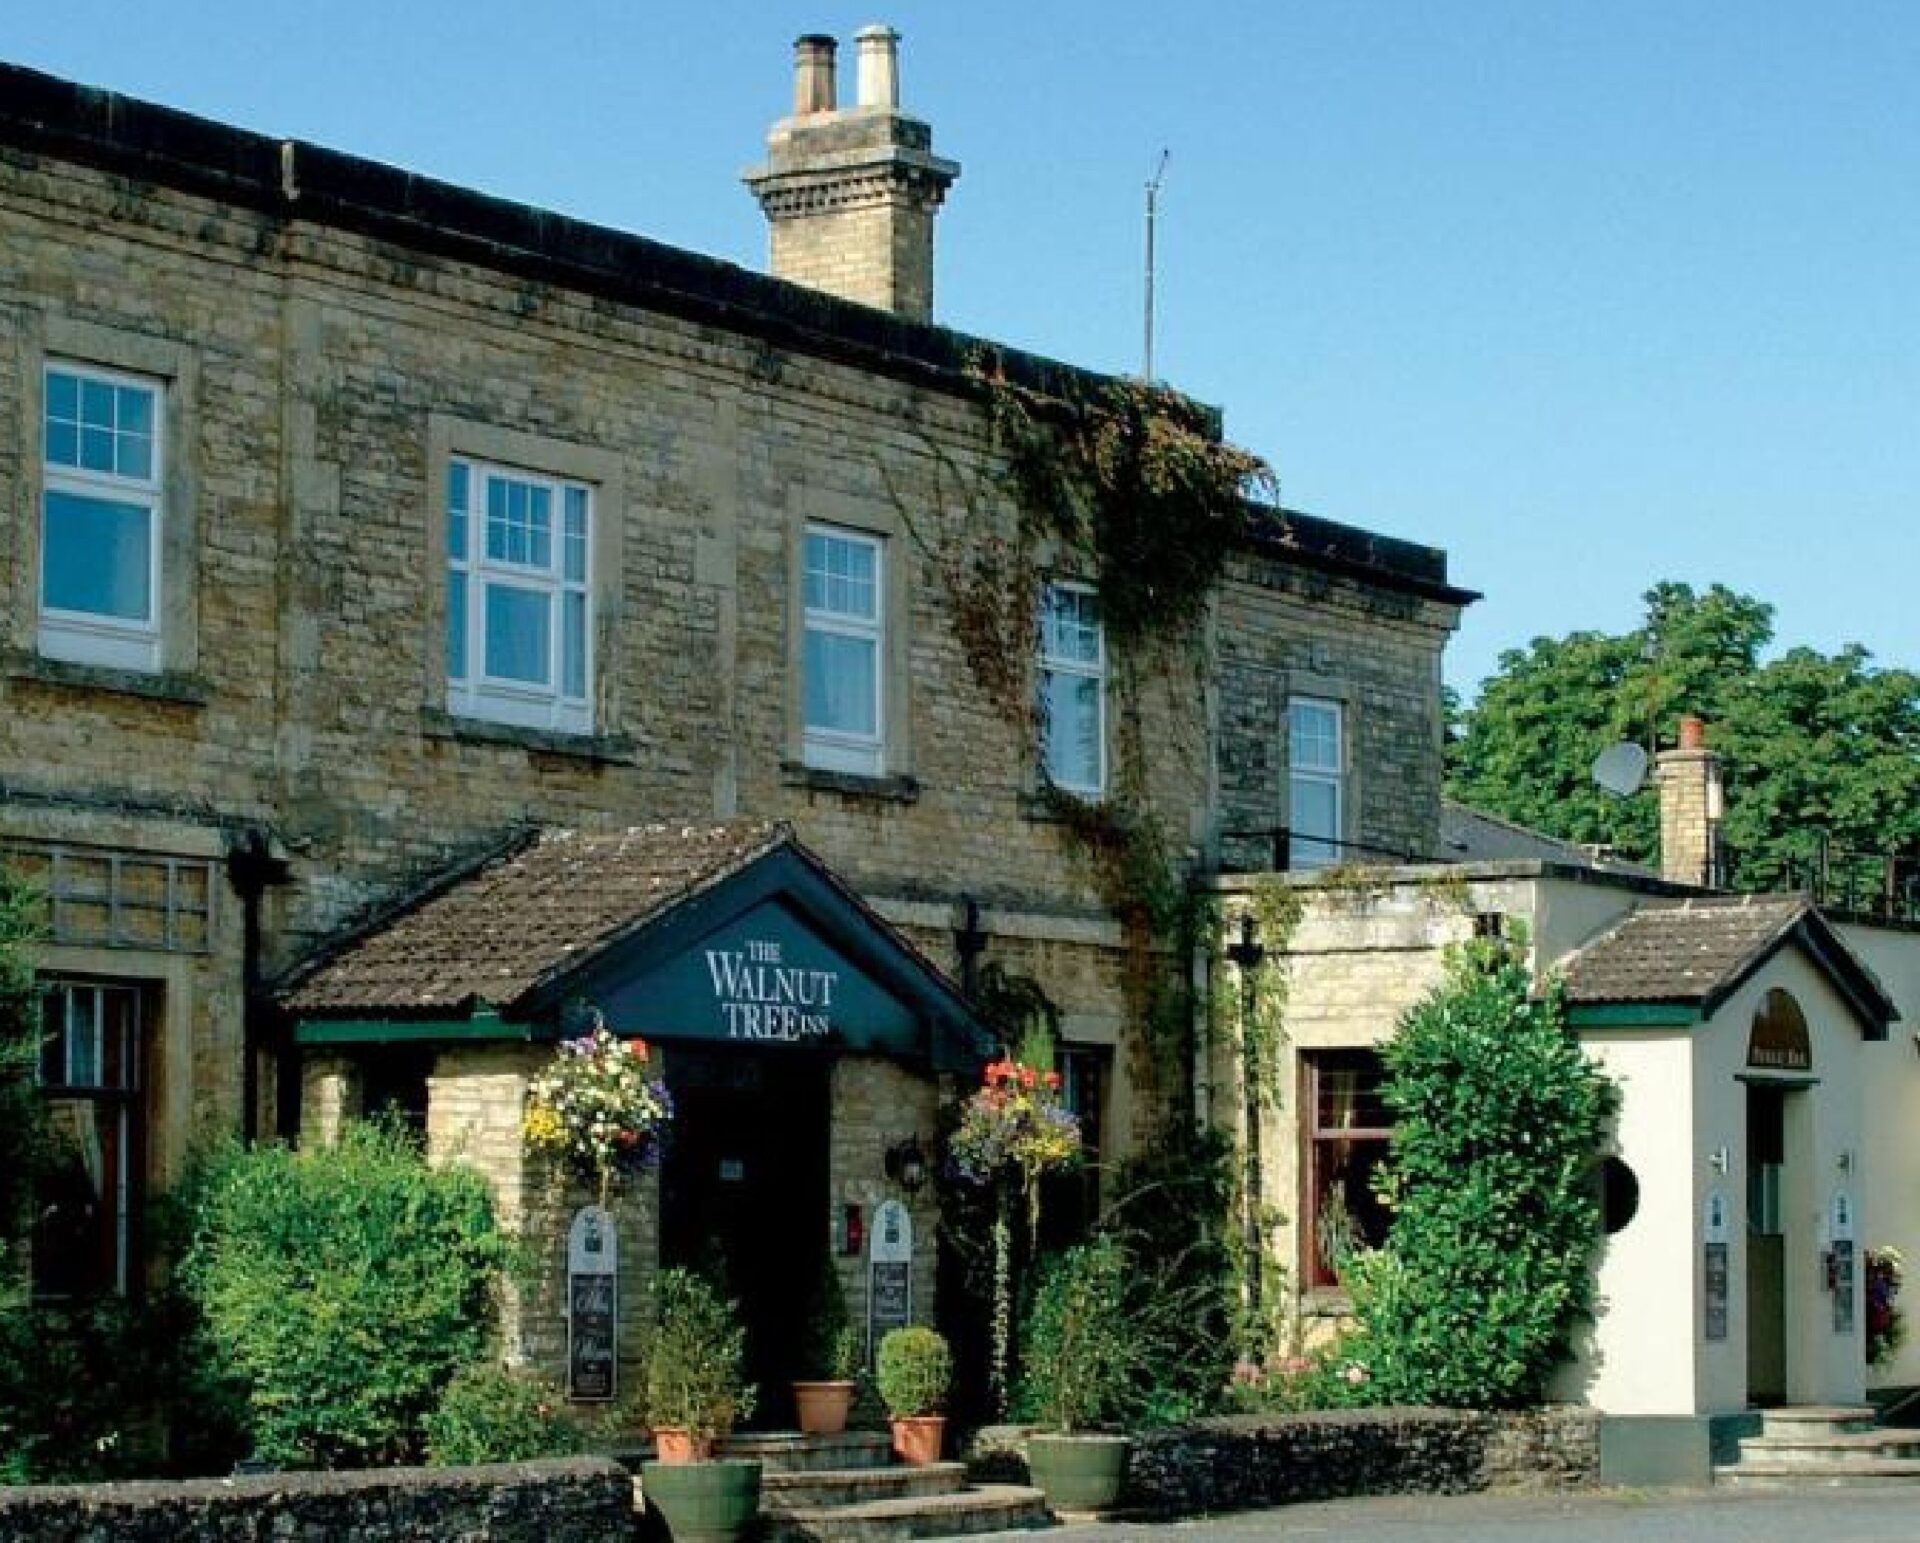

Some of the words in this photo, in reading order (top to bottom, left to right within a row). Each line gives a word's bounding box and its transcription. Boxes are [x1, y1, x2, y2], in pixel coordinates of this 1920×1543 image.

[745, 940, 780, 961] THE
[705, 950, 837, 1005] WALNUT
[722, 1003, 800, 1041] TREE
[801, 1014, 829, 1034] INN
